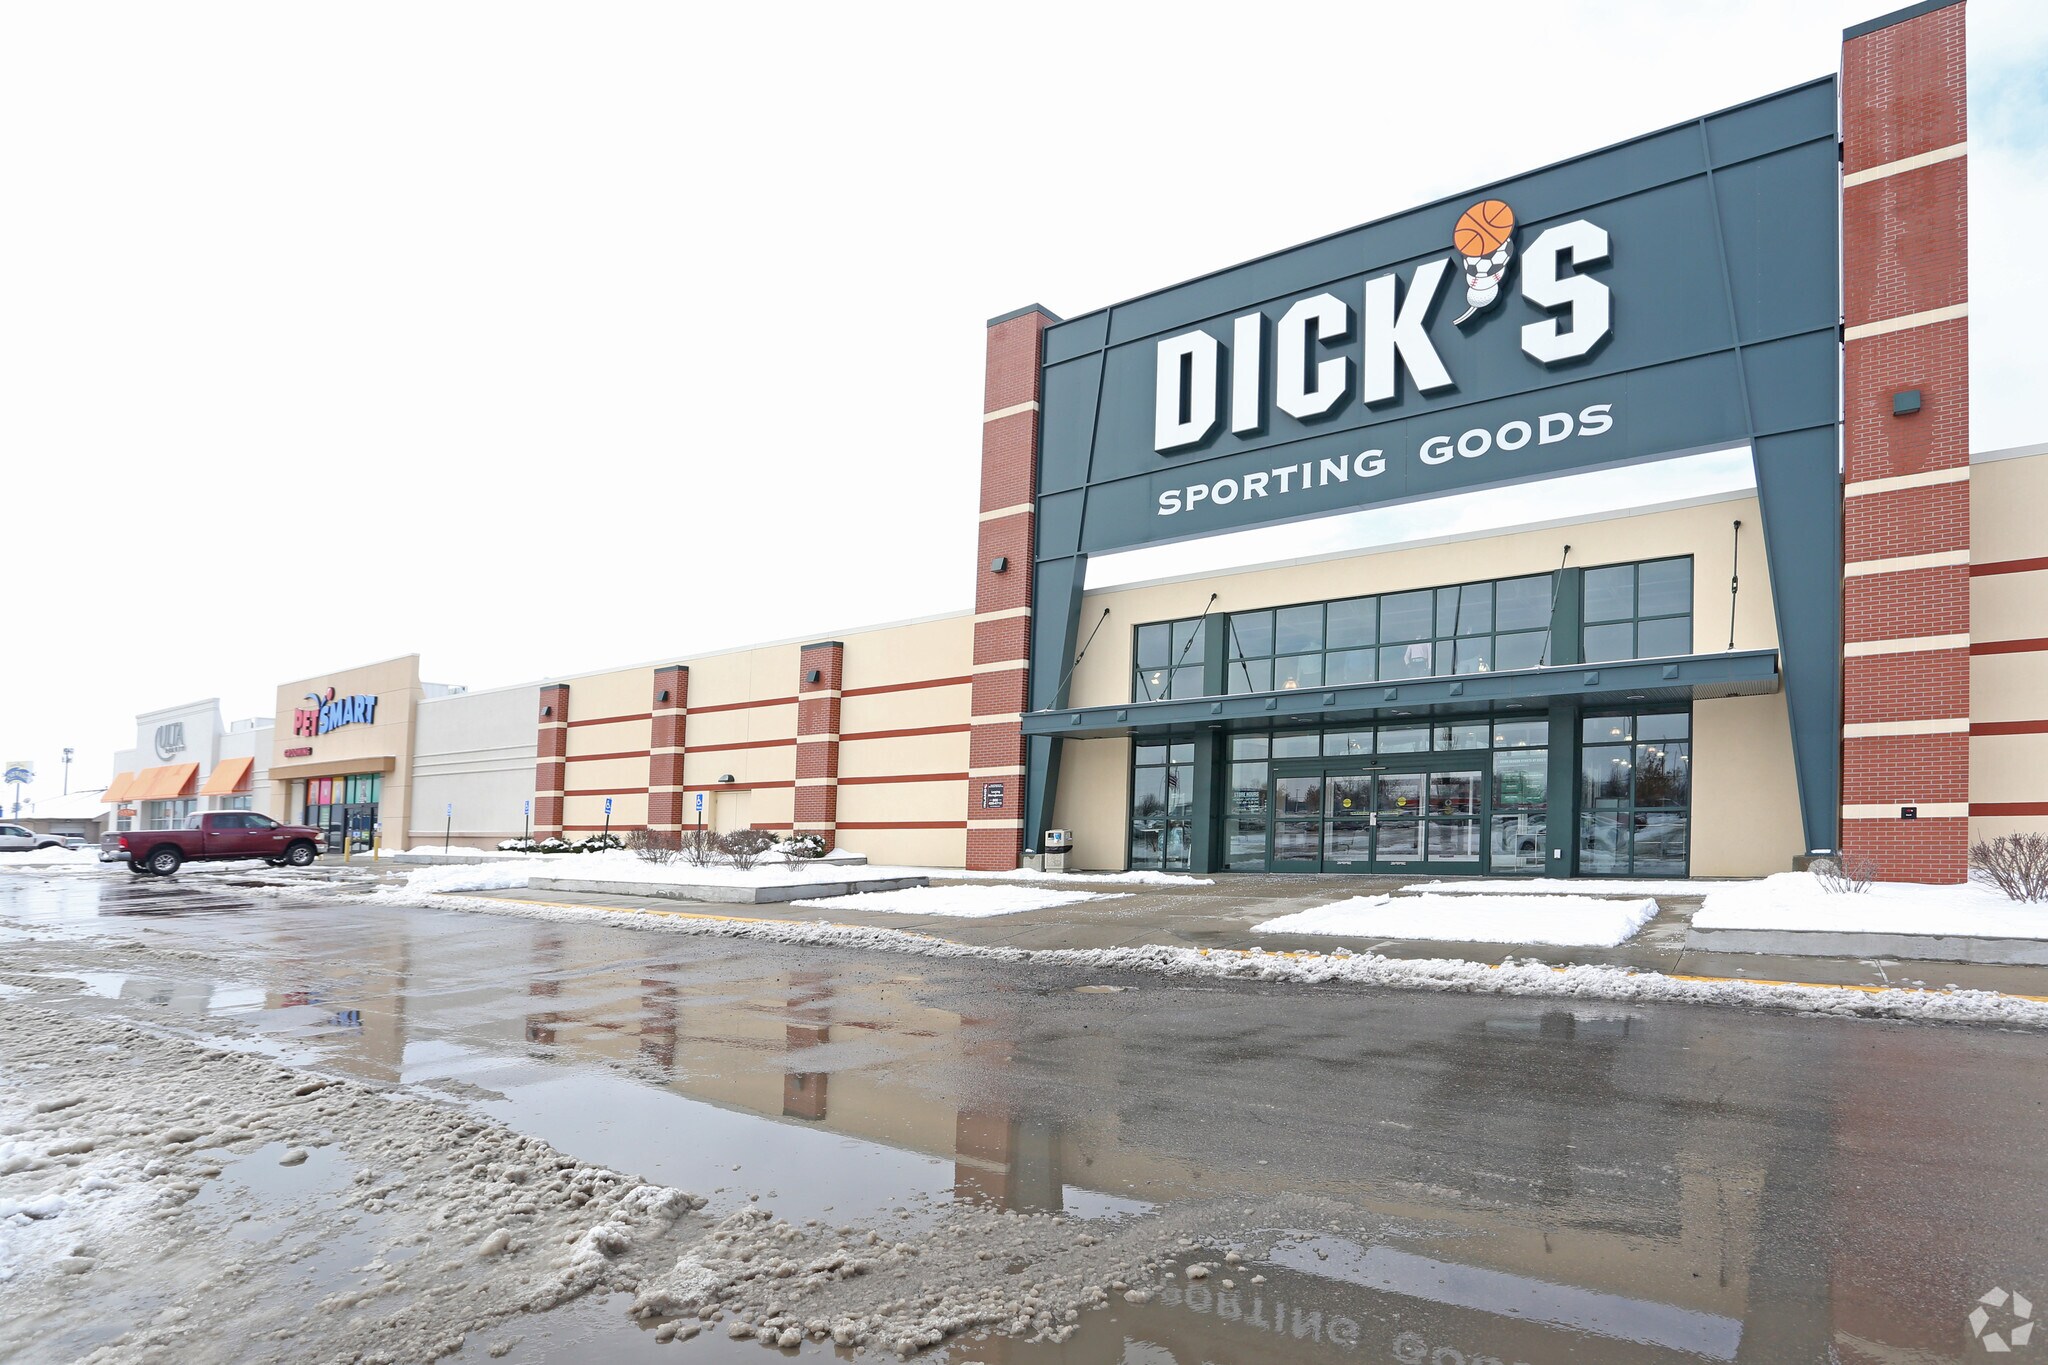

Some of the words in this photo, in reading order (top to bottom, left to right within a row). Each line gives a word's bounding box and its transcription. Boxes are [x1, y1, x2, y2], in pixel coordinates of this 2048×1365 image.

[1154, 199, 1614, 455] DICK'S
[1157, 448, 1387, 517] SPORTING
[1419, 403, 1614, 466] GOODS
[159, 722, 184, 748] ULTA
[293, 693, 378, 737] PETSMART
